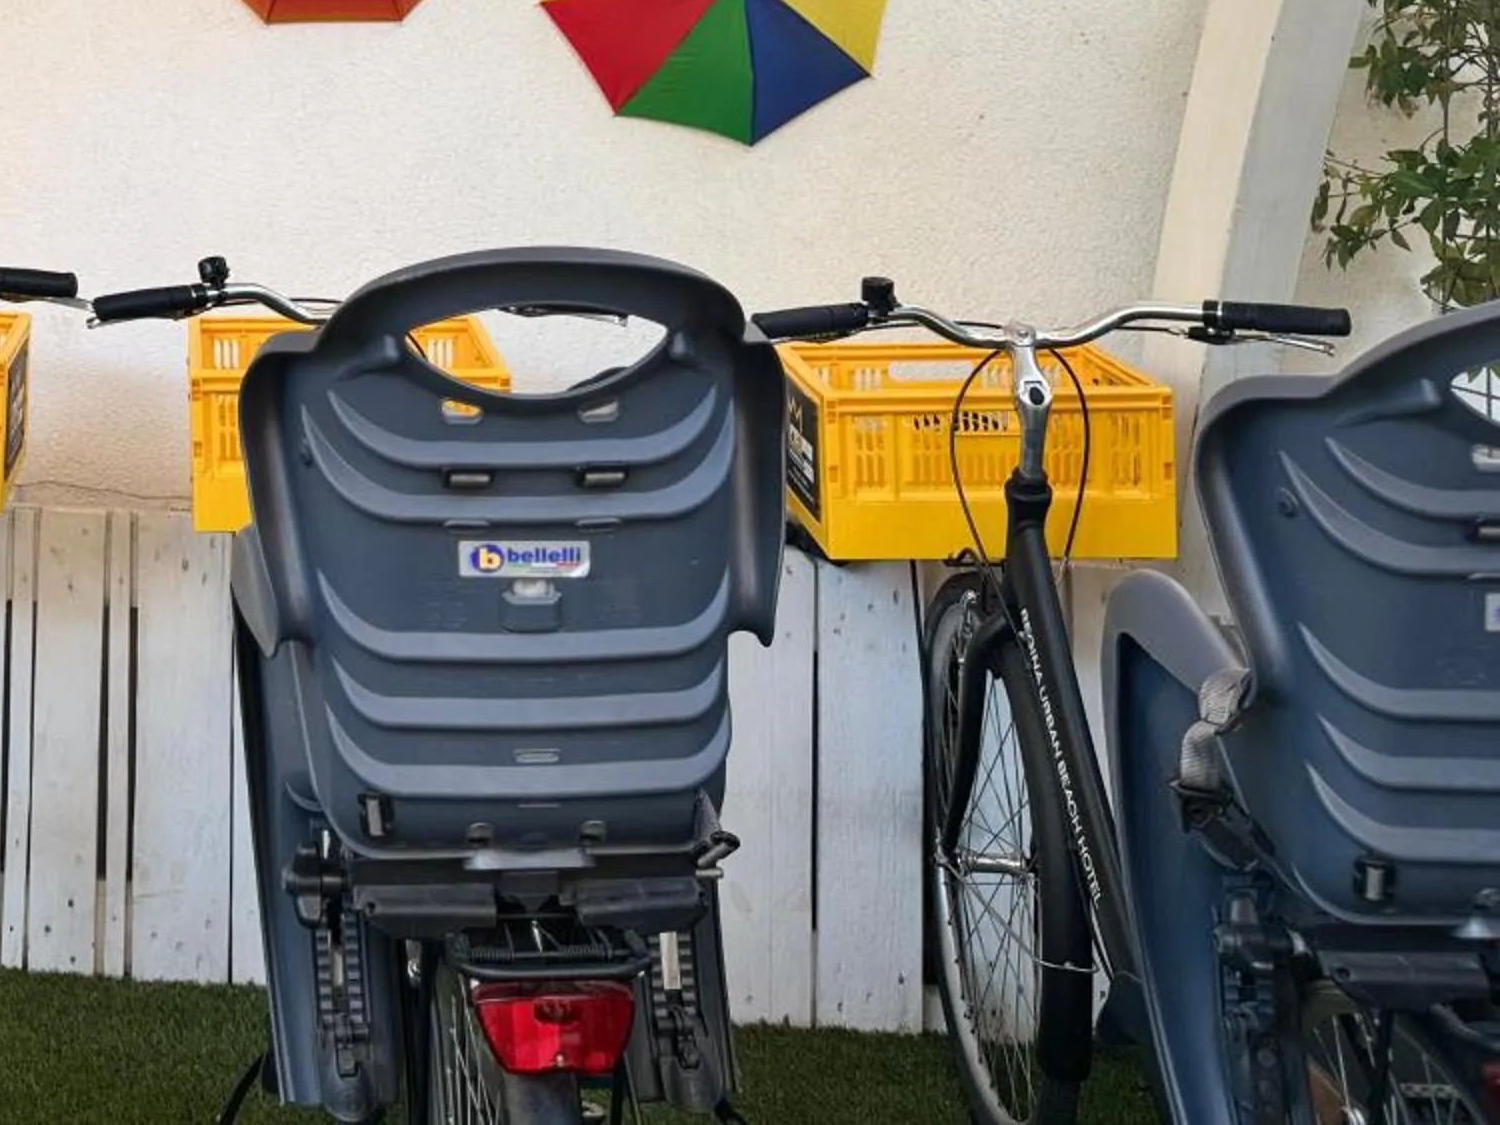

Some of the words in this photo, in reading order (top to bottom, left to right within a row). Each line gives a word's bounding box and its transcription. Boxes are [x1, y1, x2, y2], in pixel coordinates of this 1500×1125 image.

[507, 547, 581, 563] bellelli
[1020, 608, 1043, 685] REGINA
[1038, 685, 1063, 759] URBAN
[1057, 761, 1084, 834] BEACH
[1076, 836, 1102, 910] HOTEL
